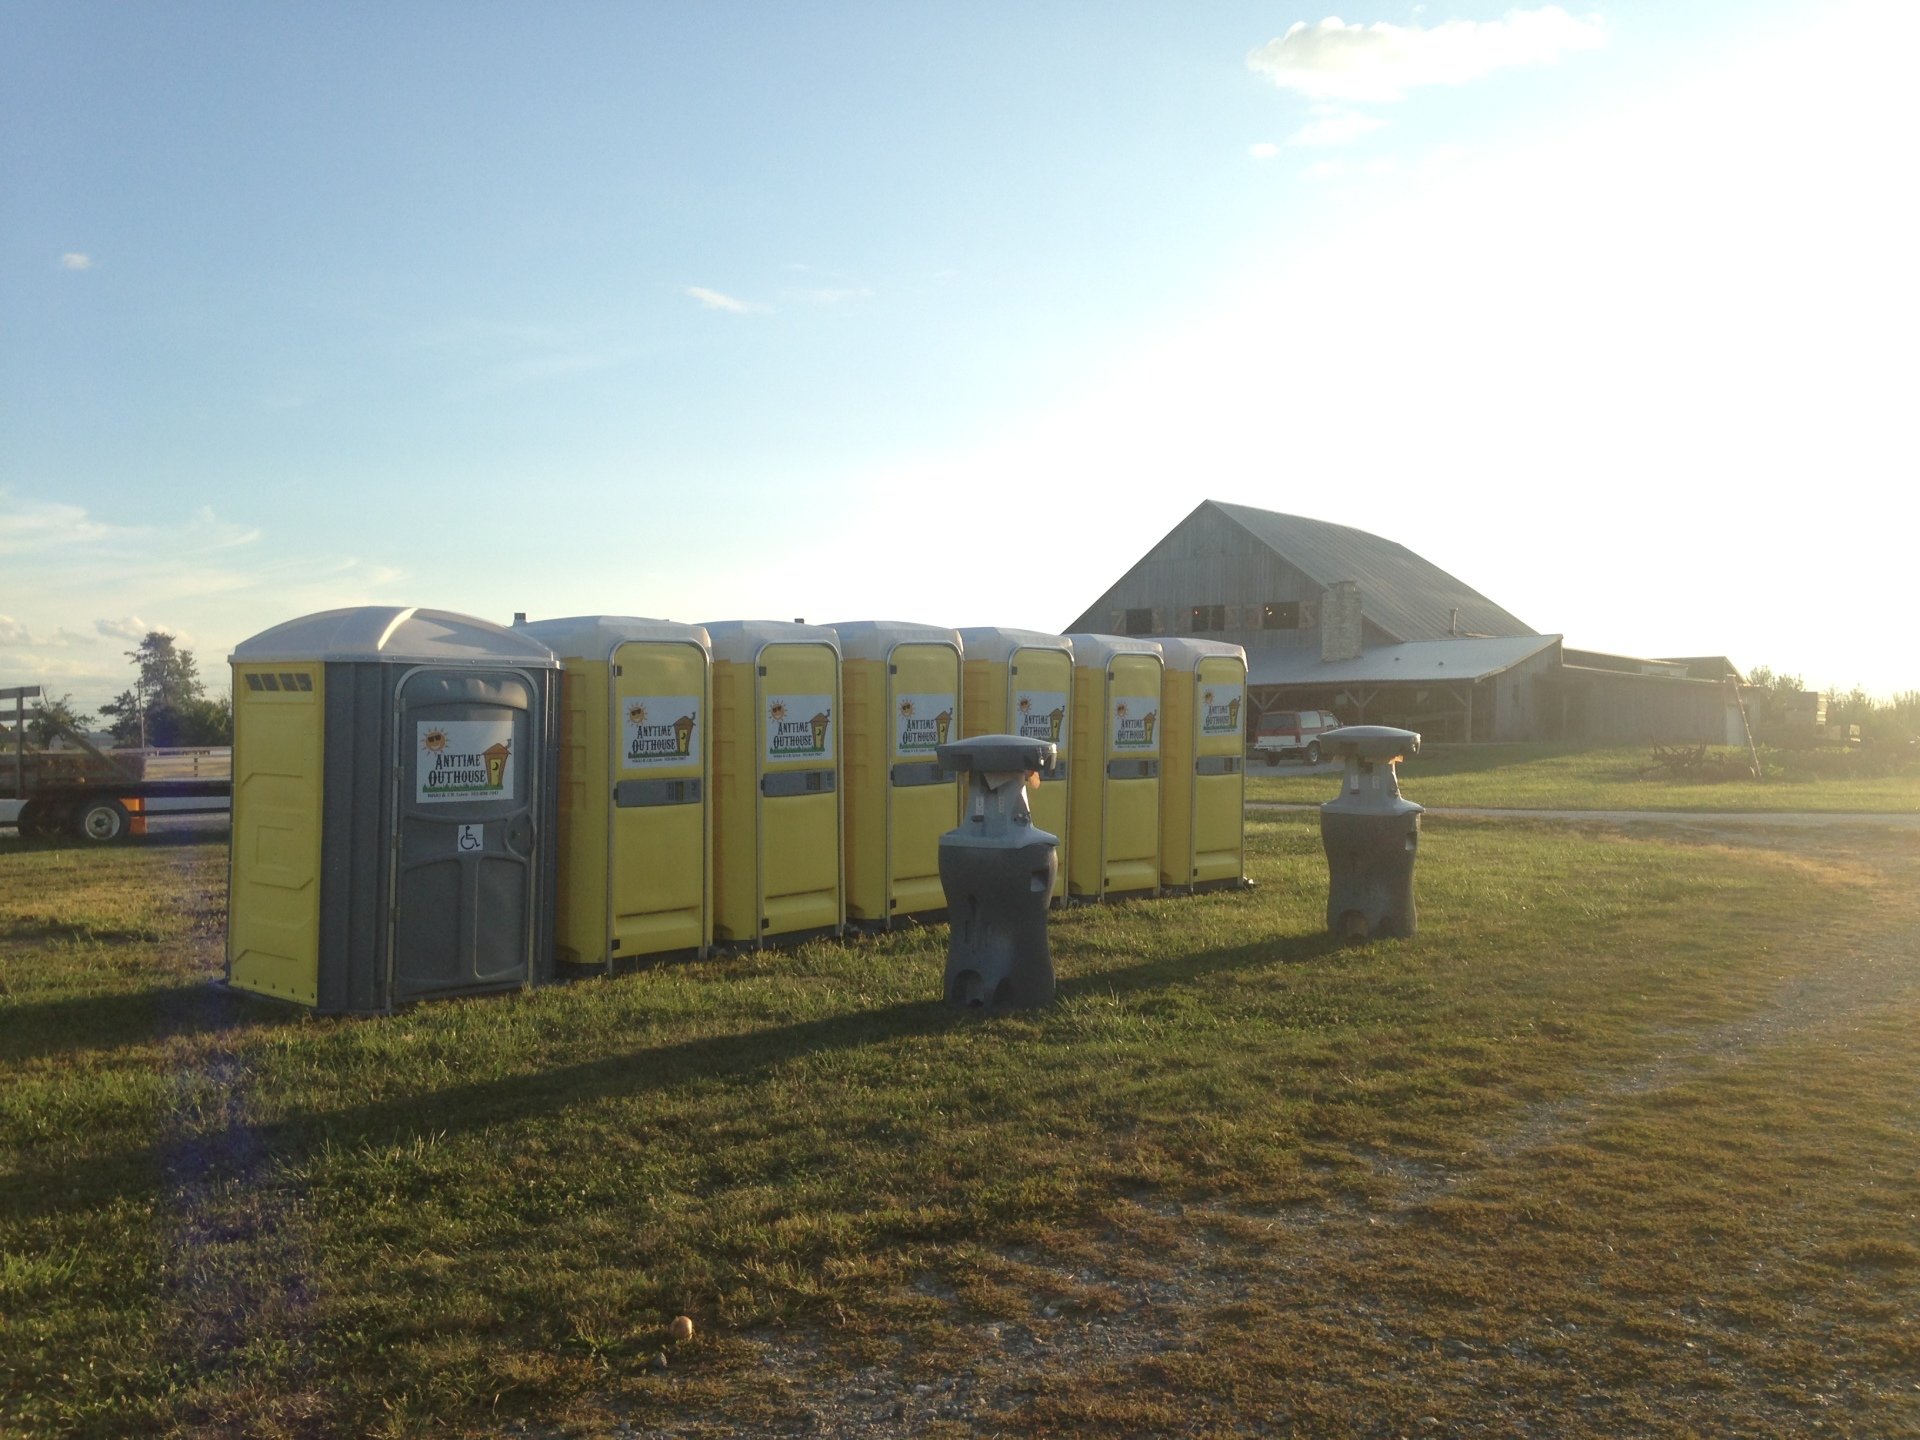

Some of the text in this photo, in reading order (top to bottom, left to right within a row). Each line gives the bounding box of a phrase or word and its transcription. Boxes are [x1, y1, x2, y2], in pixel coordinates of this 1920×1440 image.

[906, 719, 935, 731] ANYTIME
[1023, 714, 1049, 726] ANYTIME
[637, 725, 672, 739] ANYTIME
[778, 721, 809, 735] ANYTIME
[1020, 725, 1051, 737] OUTHOUSE
[773, 735, 813, 749] OUTHOUSE
[902, 731, 937, 744] OUTHOUSE
[632, 739, 676, 753] OUTHOUSE
[435, 753, 481, 770] ANYTIME
[428, 770, 486, 786] OUTHOUSE
